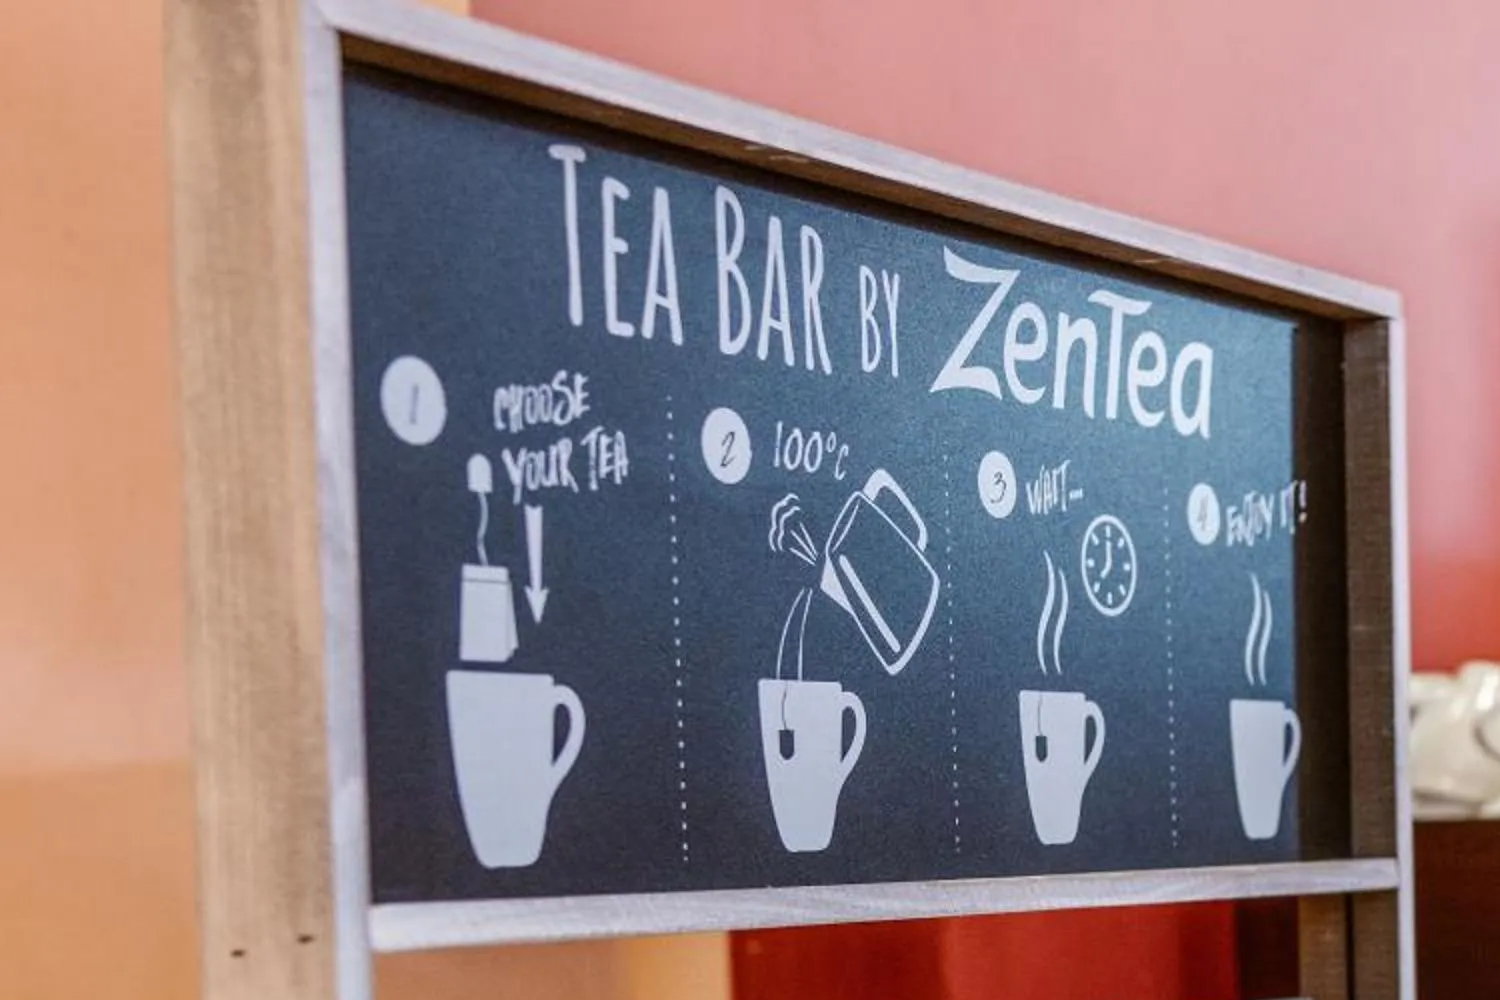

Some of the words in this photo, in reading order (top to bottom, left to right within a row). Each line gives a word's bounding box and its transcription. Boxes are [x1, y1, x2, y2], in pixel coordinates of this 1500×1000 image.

[549, 144, 683, 346] TEA
[715, 185, 832, 376] BAR
[859, 264, 900, 378] BY
[929, 245, 1214, 440] ZenTea
[493, 369, 591, 434] CHOOSE
[501, 437, 580, 506] YOUR
[580, 425, 630, 491] TEA
[719, 430, 736, 468] 2
[989, 471, 1007, 504] 3
